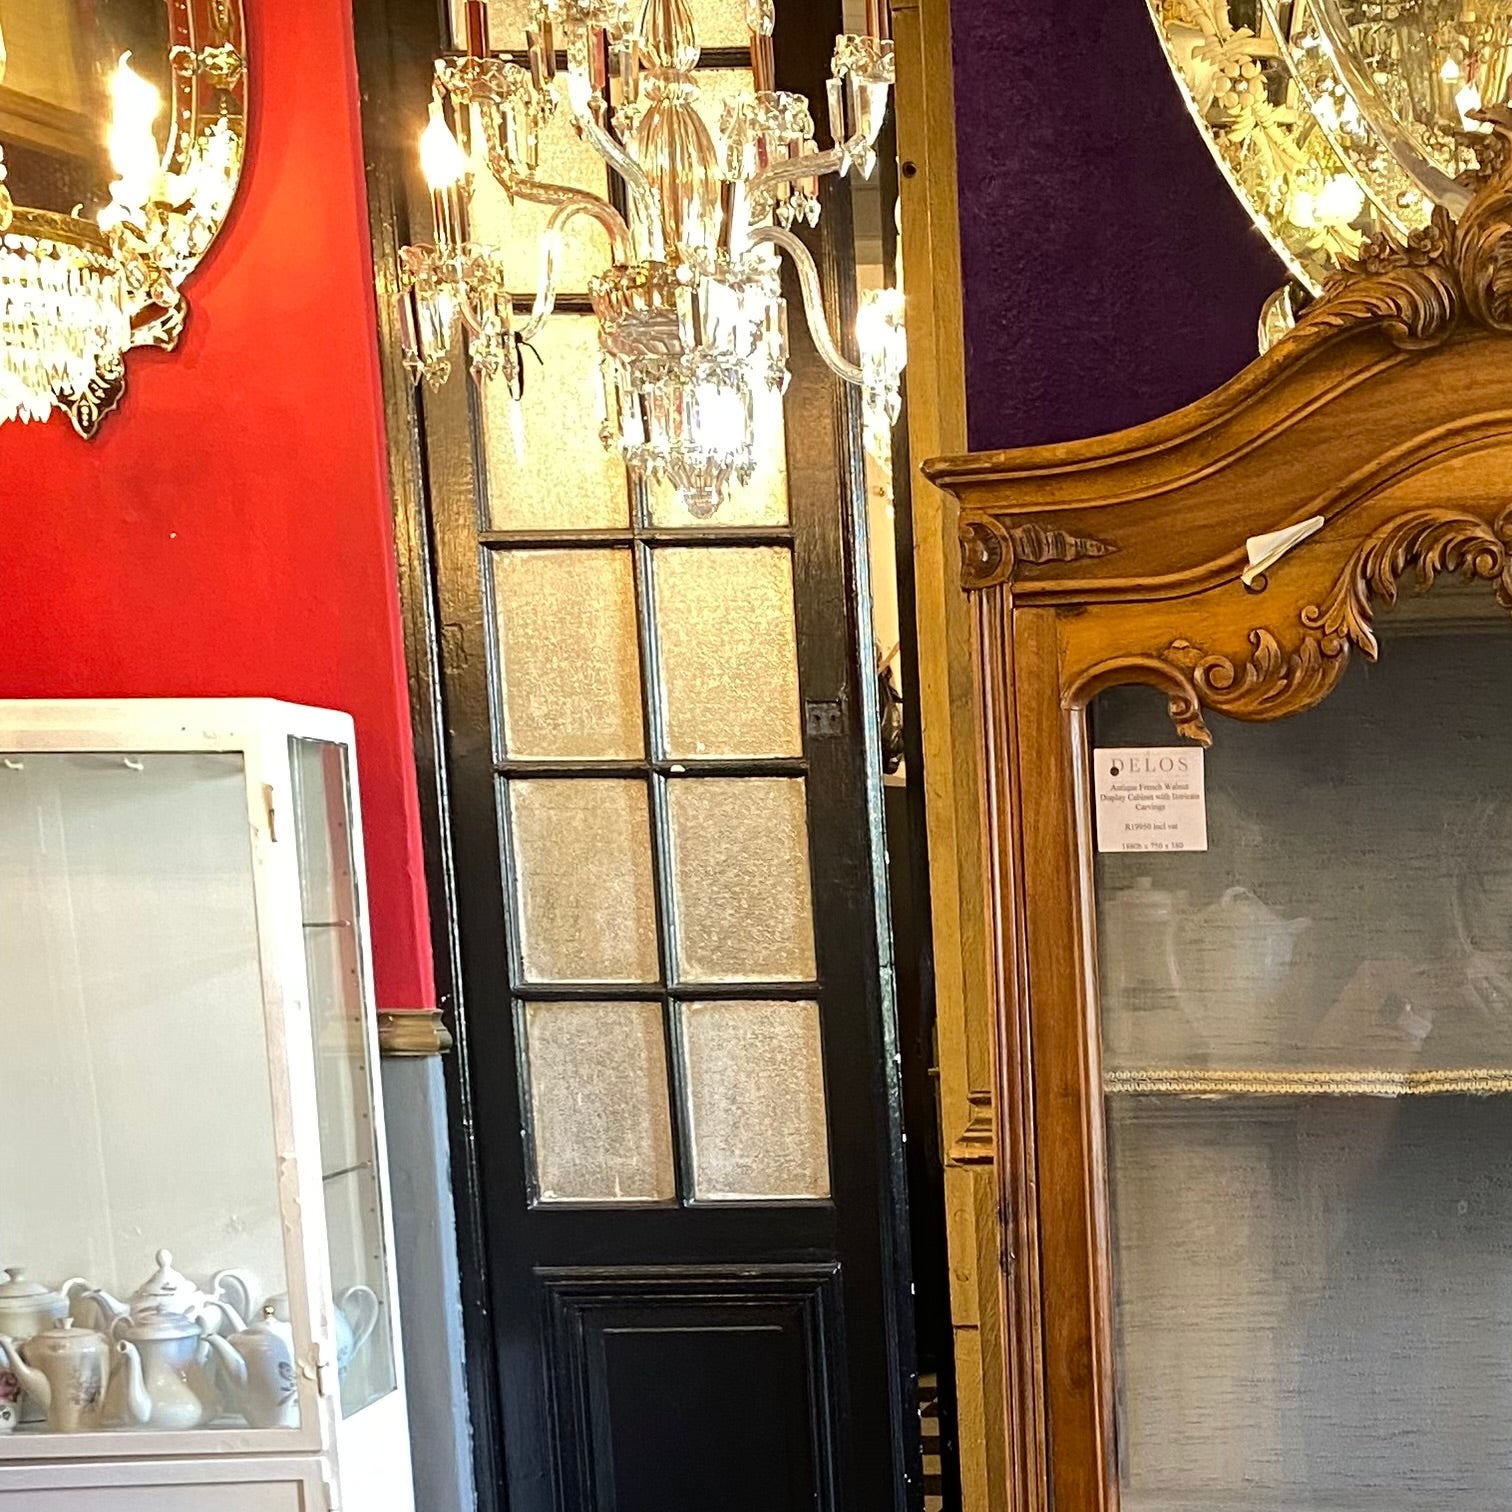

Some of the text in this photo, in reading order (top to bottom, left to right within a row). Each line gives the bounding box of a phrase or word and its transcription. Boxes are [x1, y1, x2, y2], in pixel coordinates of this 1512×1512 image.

[1111, 757, 1188, 772] DELOS
[1110, 784, 1137, 792] Antique
[1100, 794, 1125, 803] Display
[1135, 803, 1165, 811] Carvings
